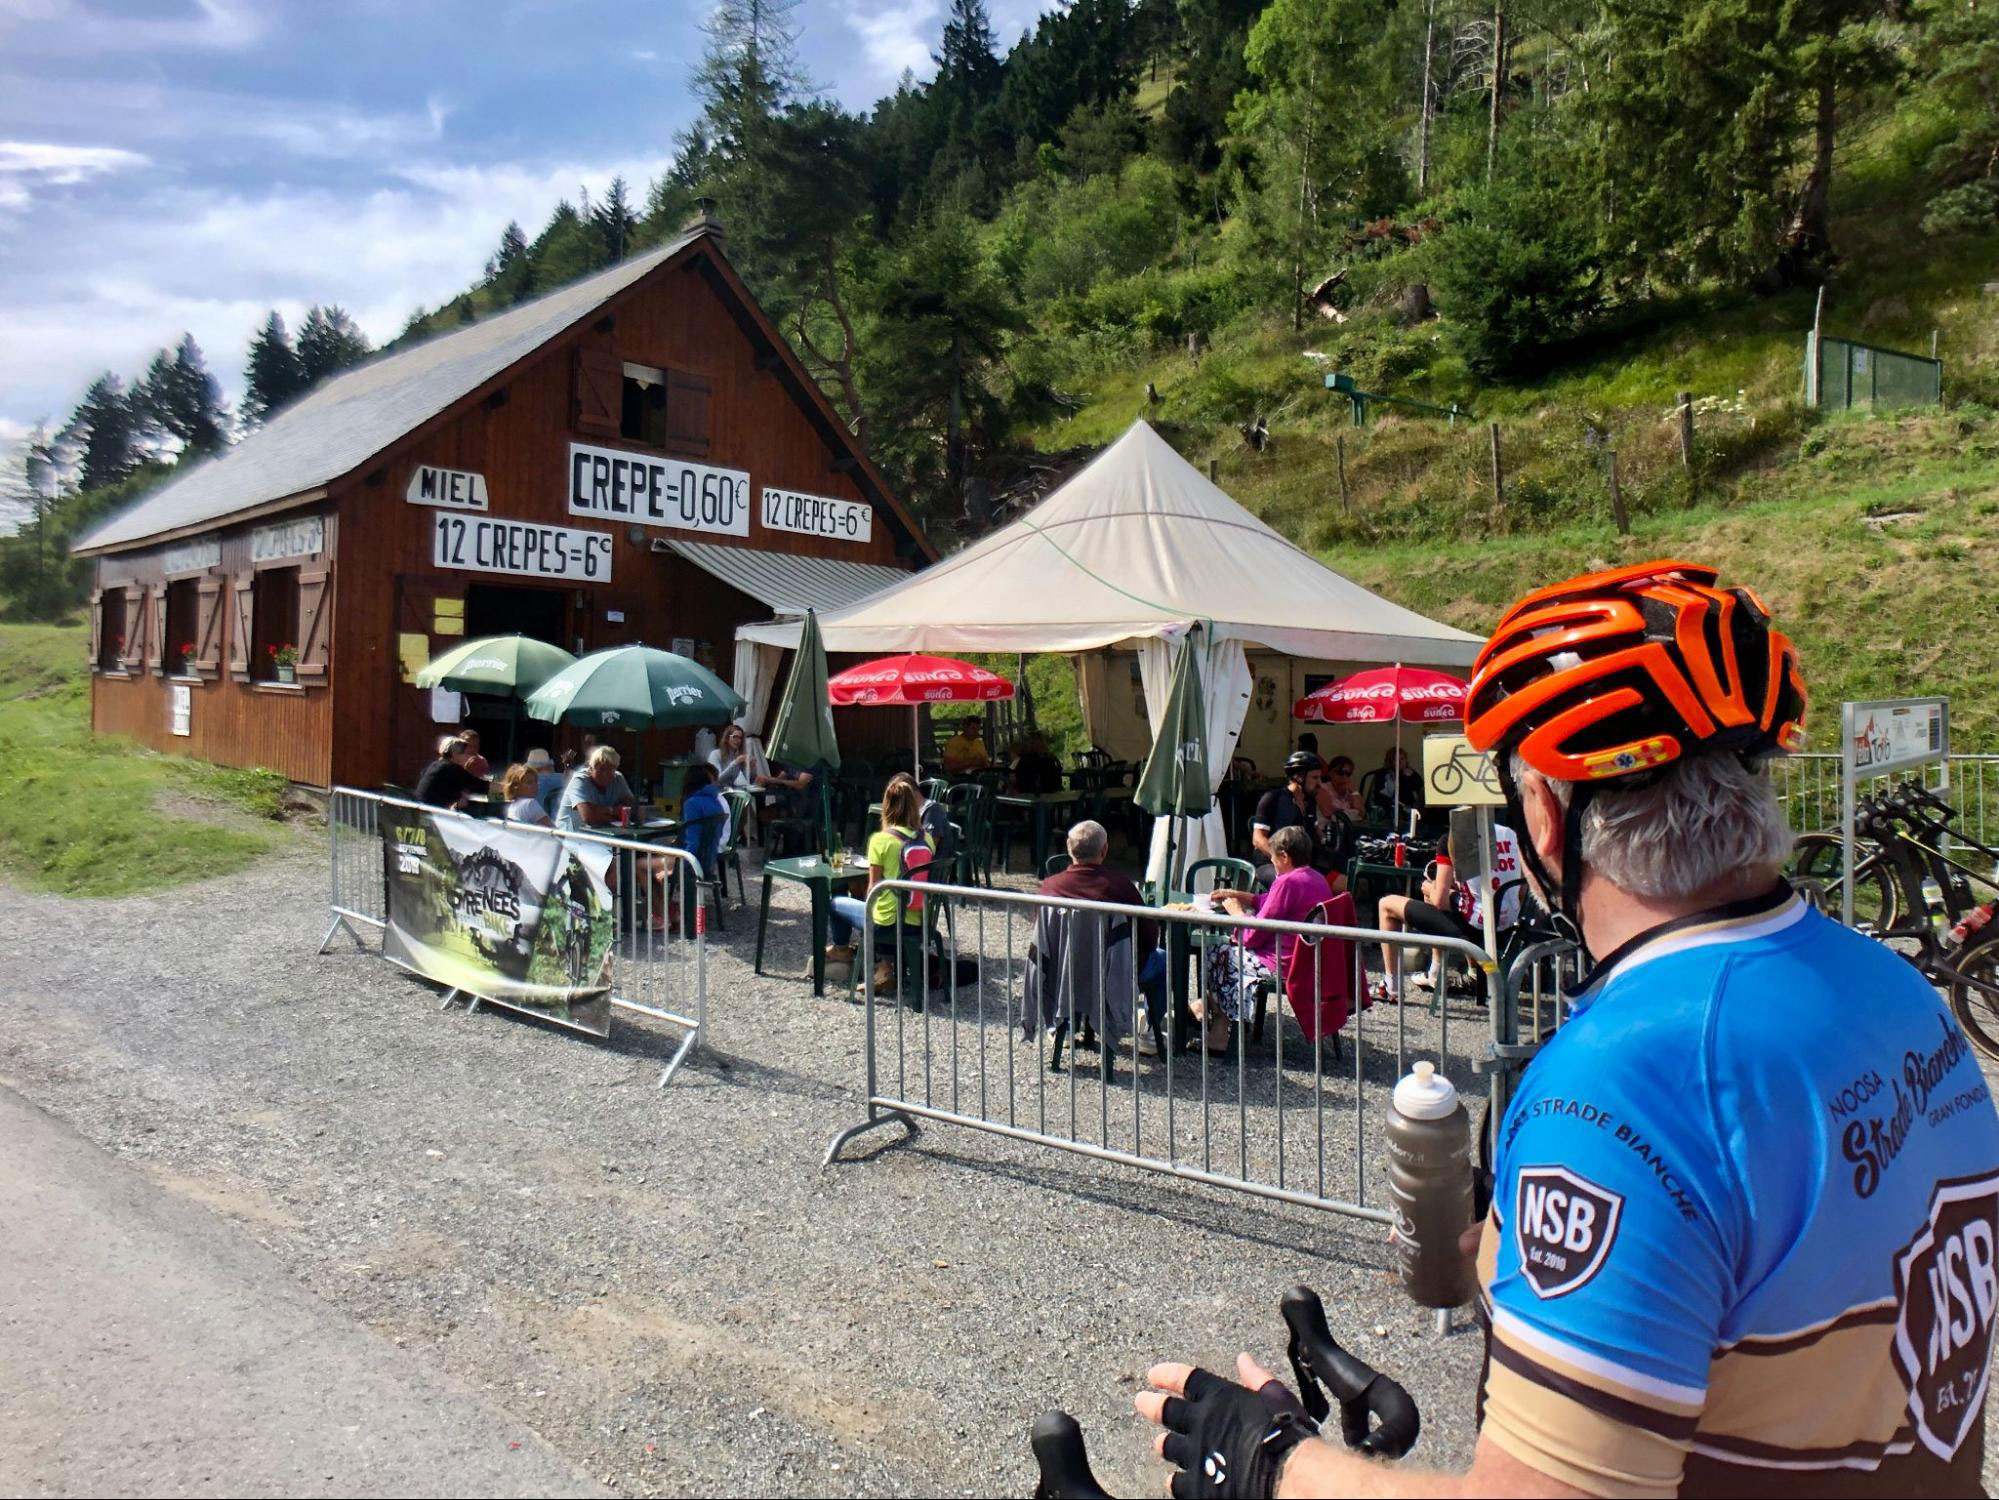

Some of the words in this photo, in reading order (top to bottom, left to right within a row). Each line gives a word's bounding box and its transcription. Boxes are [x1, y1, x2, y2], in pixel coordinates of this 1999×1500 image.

[421, 468, 483, 506] MIEL
[764, 491, 781, 526] 12
[438, 518, 466, 564] 12
[1828, 1070, 1886, 1124] NOOSA
[1842, 1078, 1913, 1200] Strade
[1903, 1012, 1968, 1117] Bianch
[1532, 1098, 1615, 1131] STRADE
[1615, 1123, 1699, 1222] BIANCHE
[1523, 1183, 1596, 1253] NSB
[1928, 1219, 1997, 1376] NSB
